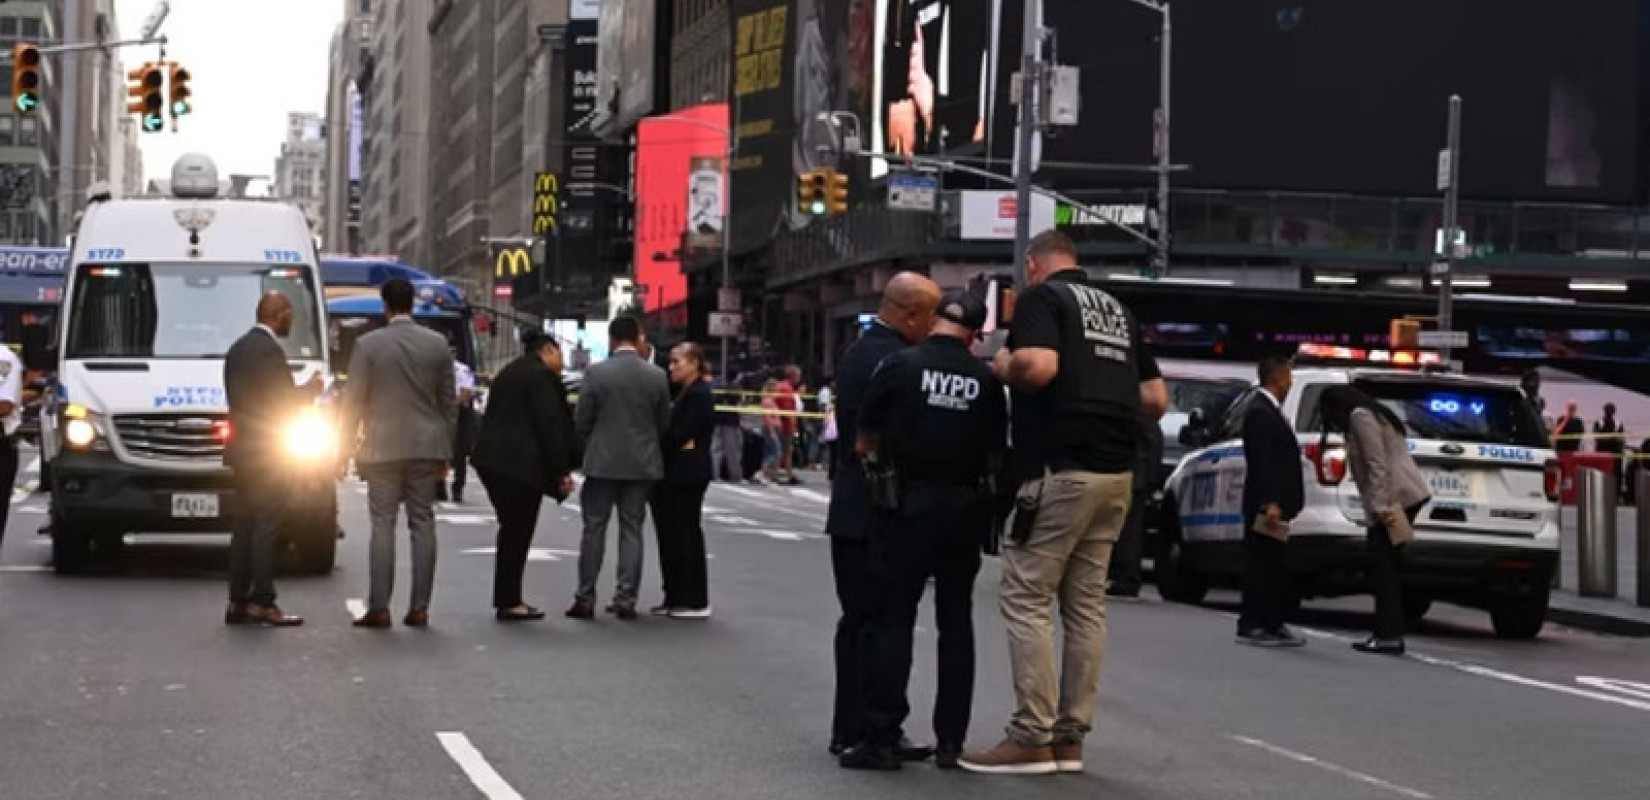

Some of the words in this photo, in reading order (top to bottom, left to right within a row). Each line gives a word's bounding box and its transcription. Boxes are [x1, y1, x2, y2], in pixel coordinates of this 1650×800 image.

[1066, 283, 1122, 316] NYPD
[1082, 308, 1129, 338] POLICE
[921, 368, 980, 400] NYPD
[1478, 445, 1534, 462] POLICE
